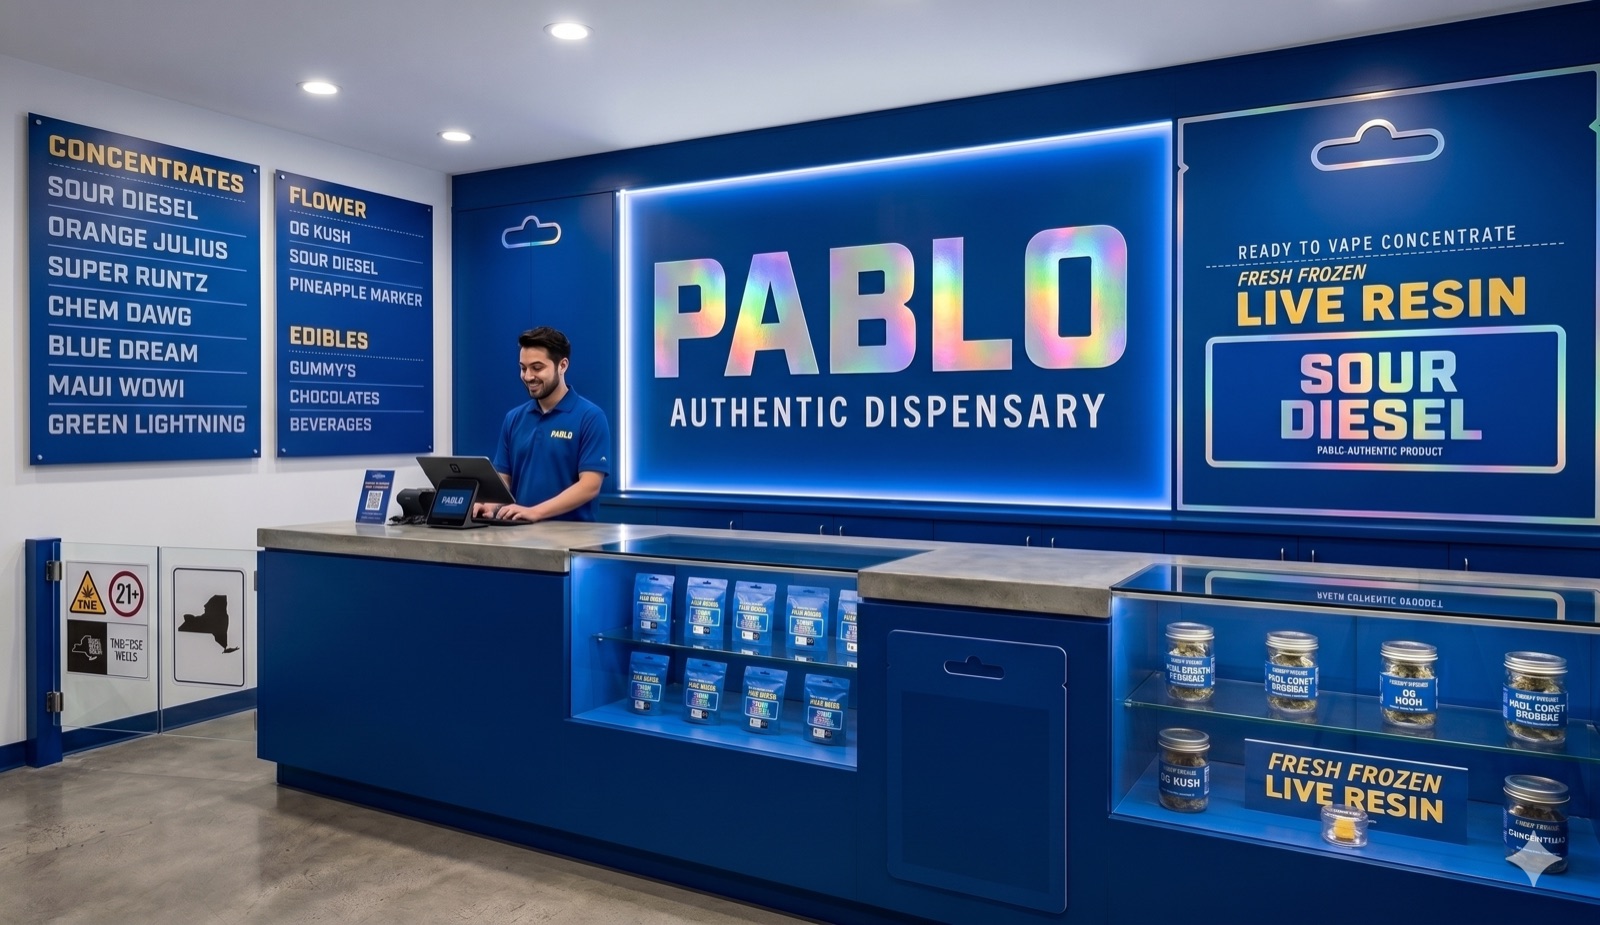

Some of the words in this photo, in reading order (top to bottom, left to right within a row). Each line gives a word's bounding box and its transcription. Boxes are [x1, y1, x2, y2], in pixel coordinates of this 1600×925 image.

[49, 134, 244, 194] CONCENTRATES
[48, 175, 114, 206] SOUR
[122, 189, 198, 220] DIESEL
[289, 185, 366, 220] FLOWER
[48, 216, 147, 249] ORANGE
[153, 232, 228, 259] JULIUS
[290, 220, 310, 237] OG
[314, 223, 351, 245] KUSH
[1238, 241, 1292, 260] READY
[1300, 240, 1320, 256] TO
[1329, 236, 1372, 254] VAPE
[1381, 225, 1517, 250] CONCENTRATE
[48, 256, 128, 284] SUPER
[136, 265, 208, 293] RUNTZ
[289, 249, 328, 269] SOUR
[333, 256, 378, 276] DIESEL
[1238, 269, 1292, 287] FRESH
[1297, 263, 1367, 283] FROZEN
[290, 277, 366, 301] PINEAPPLE
[370, 288, 422, 307] MARKER
[654, 224, 1127, 378] PABLO
[1237, 286, 1345, 327] LIVE
[1362, 276, 1527, 322] RESIN
[48, 295, 119, 321] CHEM
[127, 302, 192, 326] DAWG
[49, 334, 110, 359] BLUE
[119, 339, 198, 363] DREAM
[290, 325, 368, 350] EDIBLES
[289, 360, 356, 378] GUMMY'S
[1300, 350, 1458, 394] SOUR
[49, 374, 112, 397] MAUI
[118, 378, 184, 398] WOWI
[289, 389, 380, 406] CHOCOLATES
[48, 414, 128, 435] GREEN
[135, 414, 245, 434] LIGHTNING
[290, 417, 372, 432] BEVERAGES
[670, 395, 847, 428] AUTHENTIC
[865, 393, 1105, 429] DISPENSARY
[1280, 398, 1483, 440] DIESEL
[550, 430, 573, 440] PABLO
[1400, 446, 1443, 457] PRODUCT
[77, 599, 97, 610] TNE
[116, 583, 139, 605] 21+
[1402, 689, 1416, 698] OG
[1173, 776, 1200, 788] KUSH
[1268, 751, 1342, 781] FRESH
[1347, 763, 1442, 794] FROZEN
[1265, 774, 1333, 806] LIVE
[1345, 786, 1444, 824] RESIN
